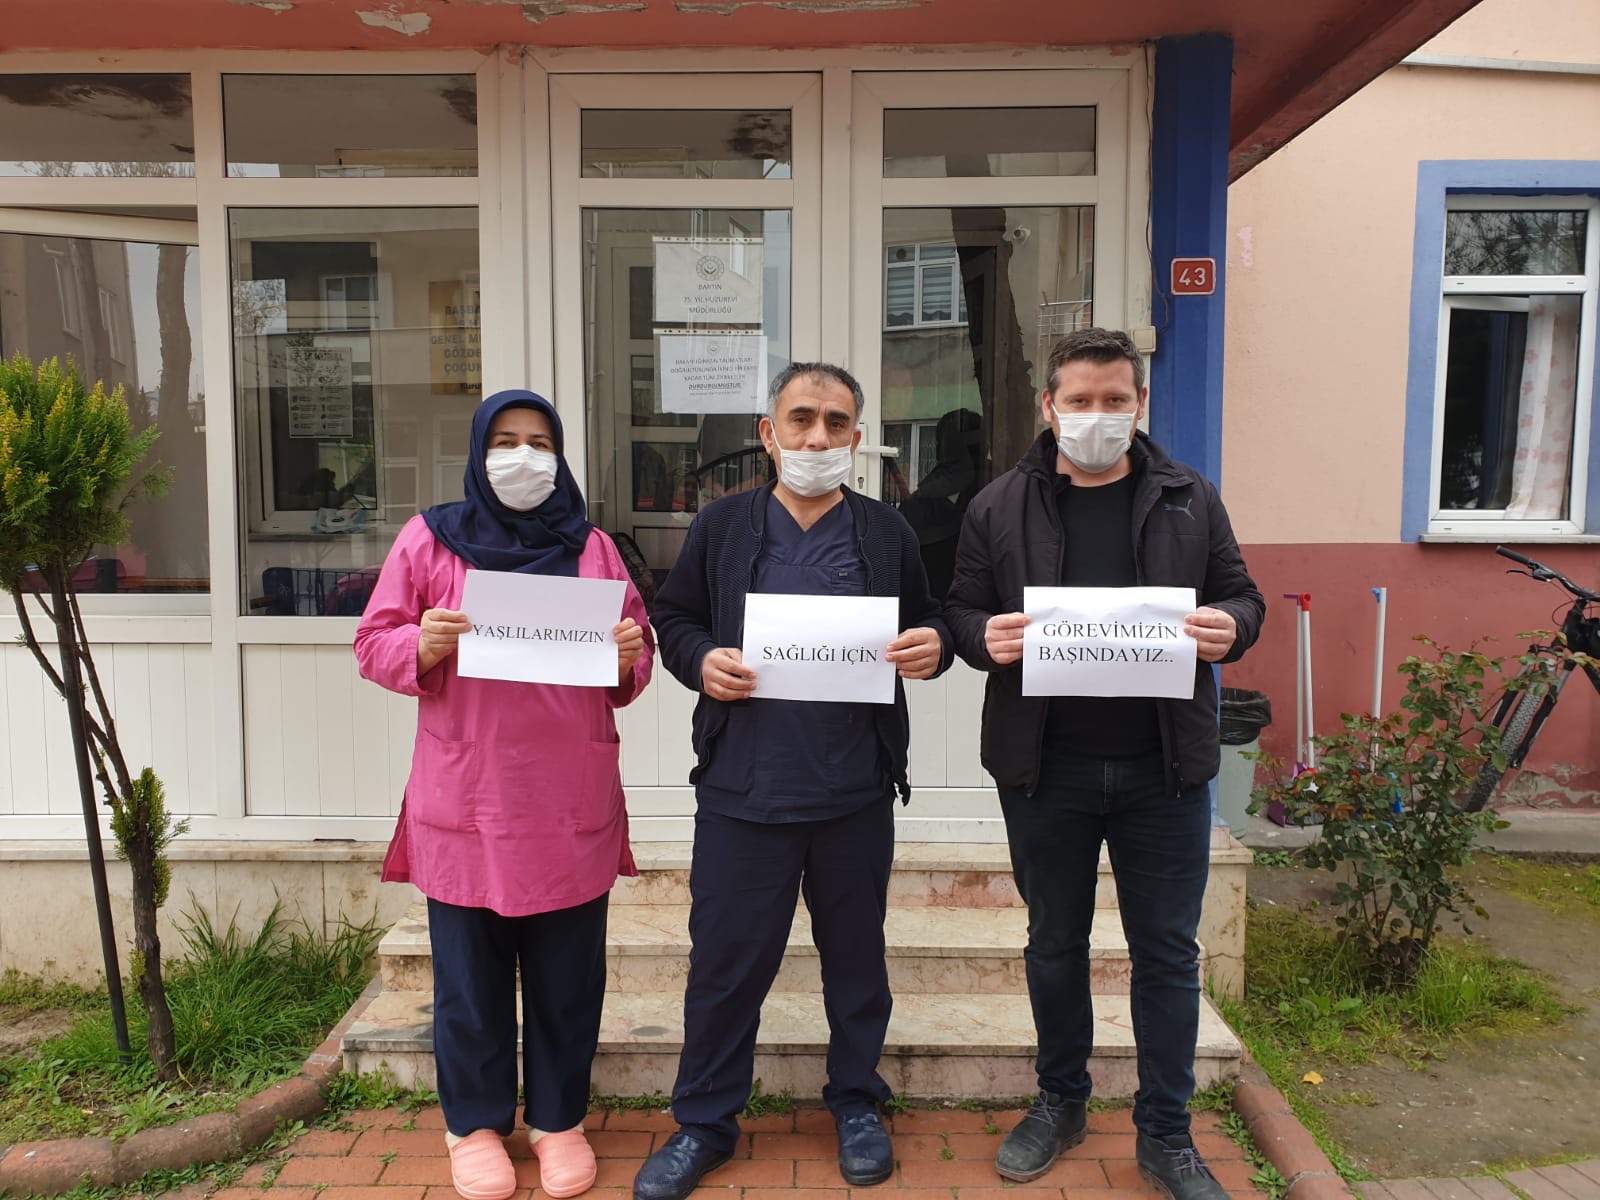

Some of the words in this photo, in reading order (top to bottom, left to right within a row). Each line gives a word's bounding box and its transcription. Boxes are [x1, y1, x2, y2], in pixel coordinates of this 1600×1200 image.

[1179, 267, 1206, 286] 43
[473, 624, 606, 643] YAŞLILARIMIZIN
[1043, 620, 1178, 639] GÖREVİMİZİN
[763, 644, 836, 662] SAĞLIĞI
[841, 645, 878, 665] İÇİN
[1039, 646, 1174, 664] BAŞINDAYIZ..
